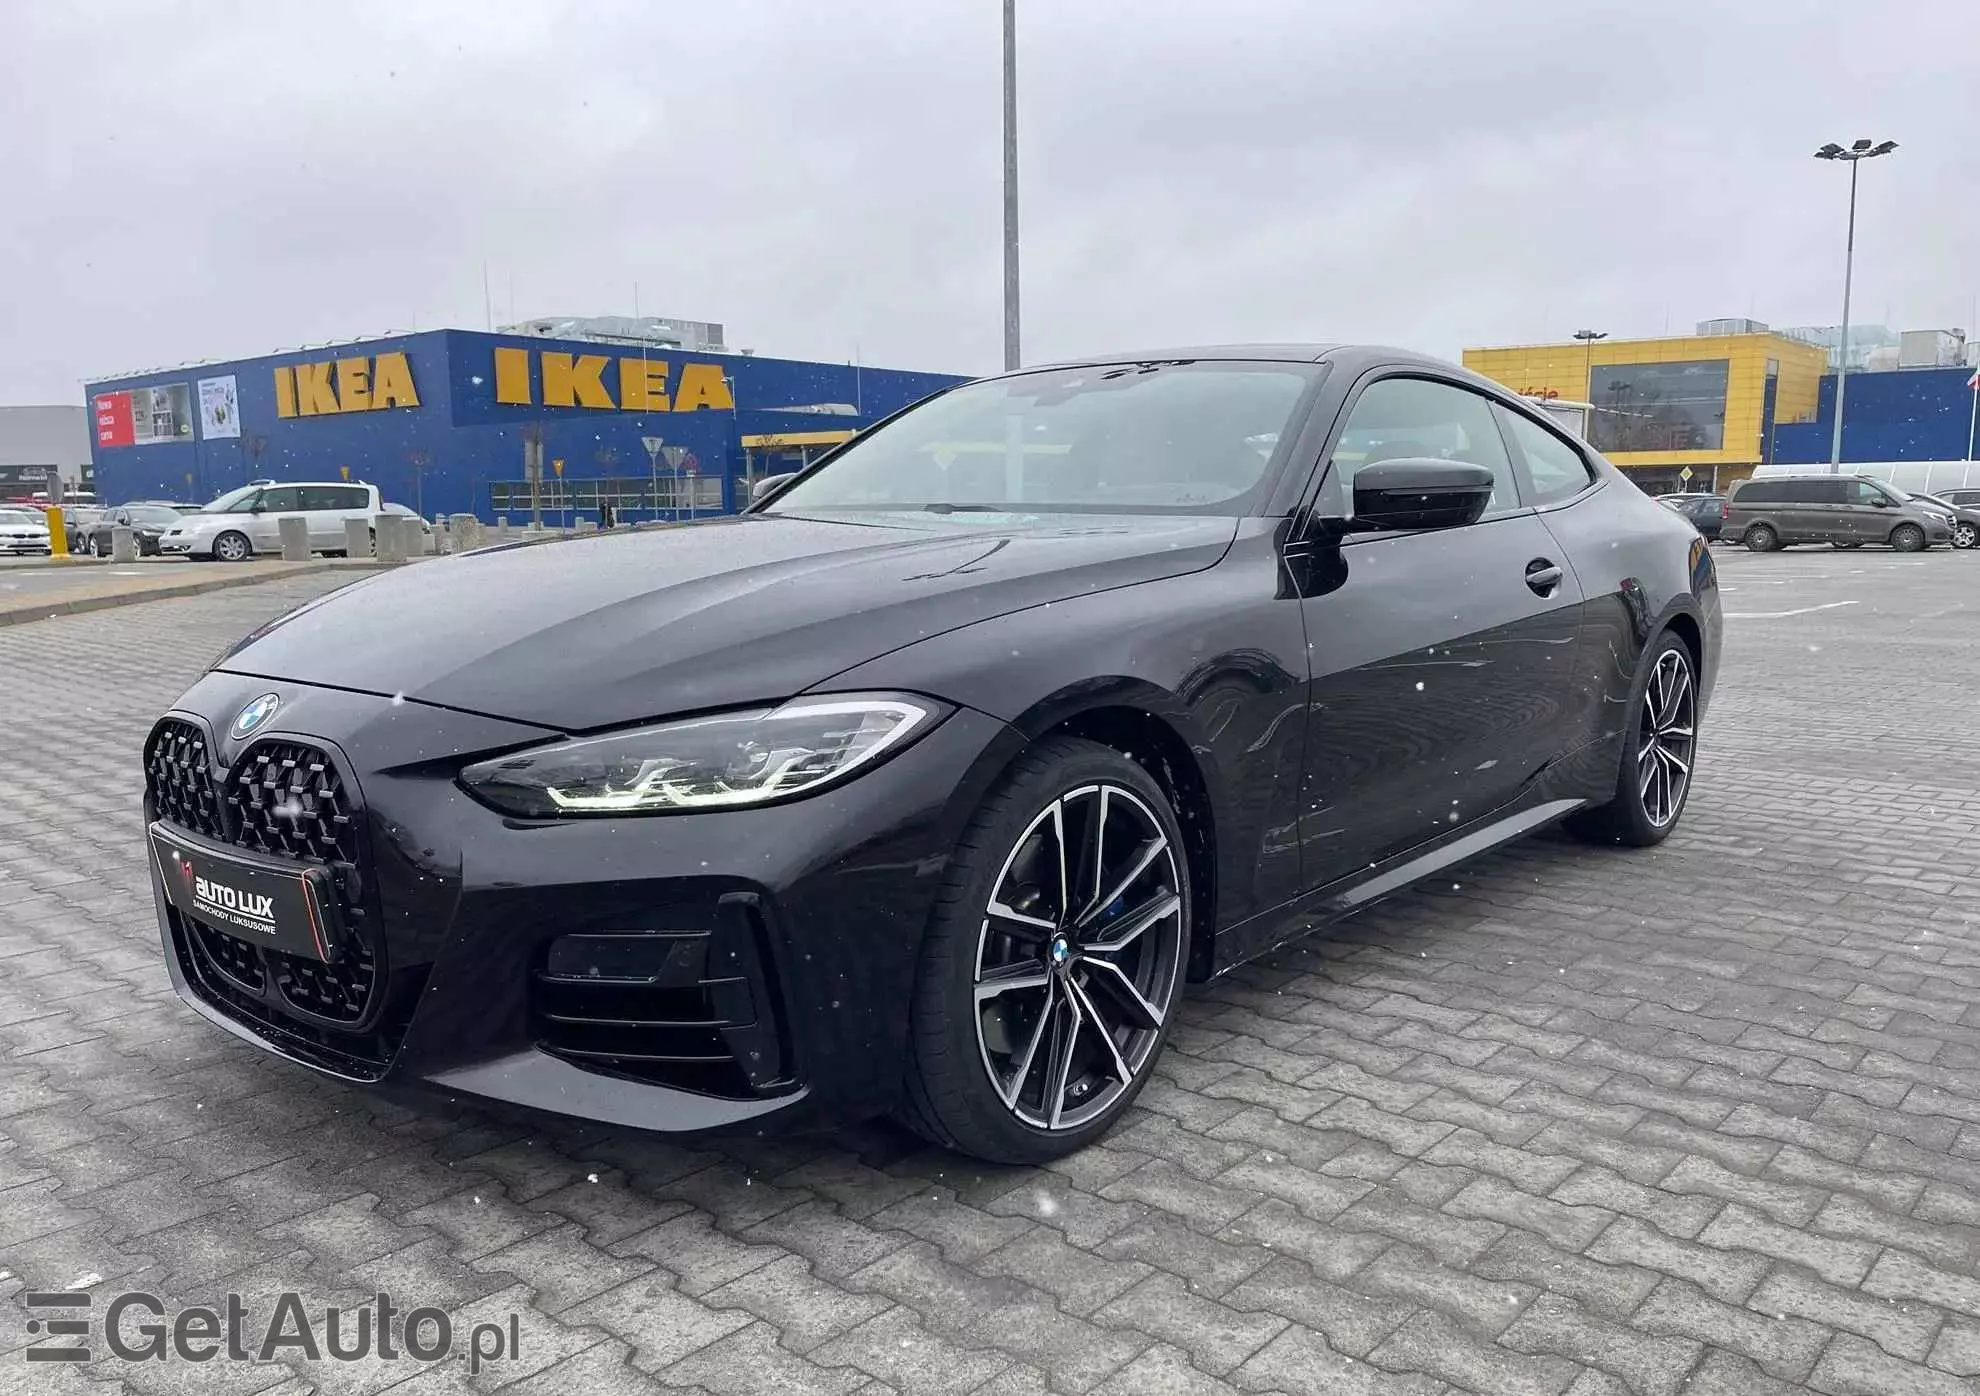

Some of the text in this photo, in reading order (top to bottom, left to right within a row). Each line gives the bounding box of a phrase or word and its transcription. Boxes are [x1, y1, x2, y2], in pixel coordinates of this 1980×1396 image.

[274, 352, 420, 418] IKEA
[495, 347, 734, 412] IKEA
[193, 899, 276, 934] SAMOCHODY LUKSUSOWE
[238, 890, 274, 919] LUX
